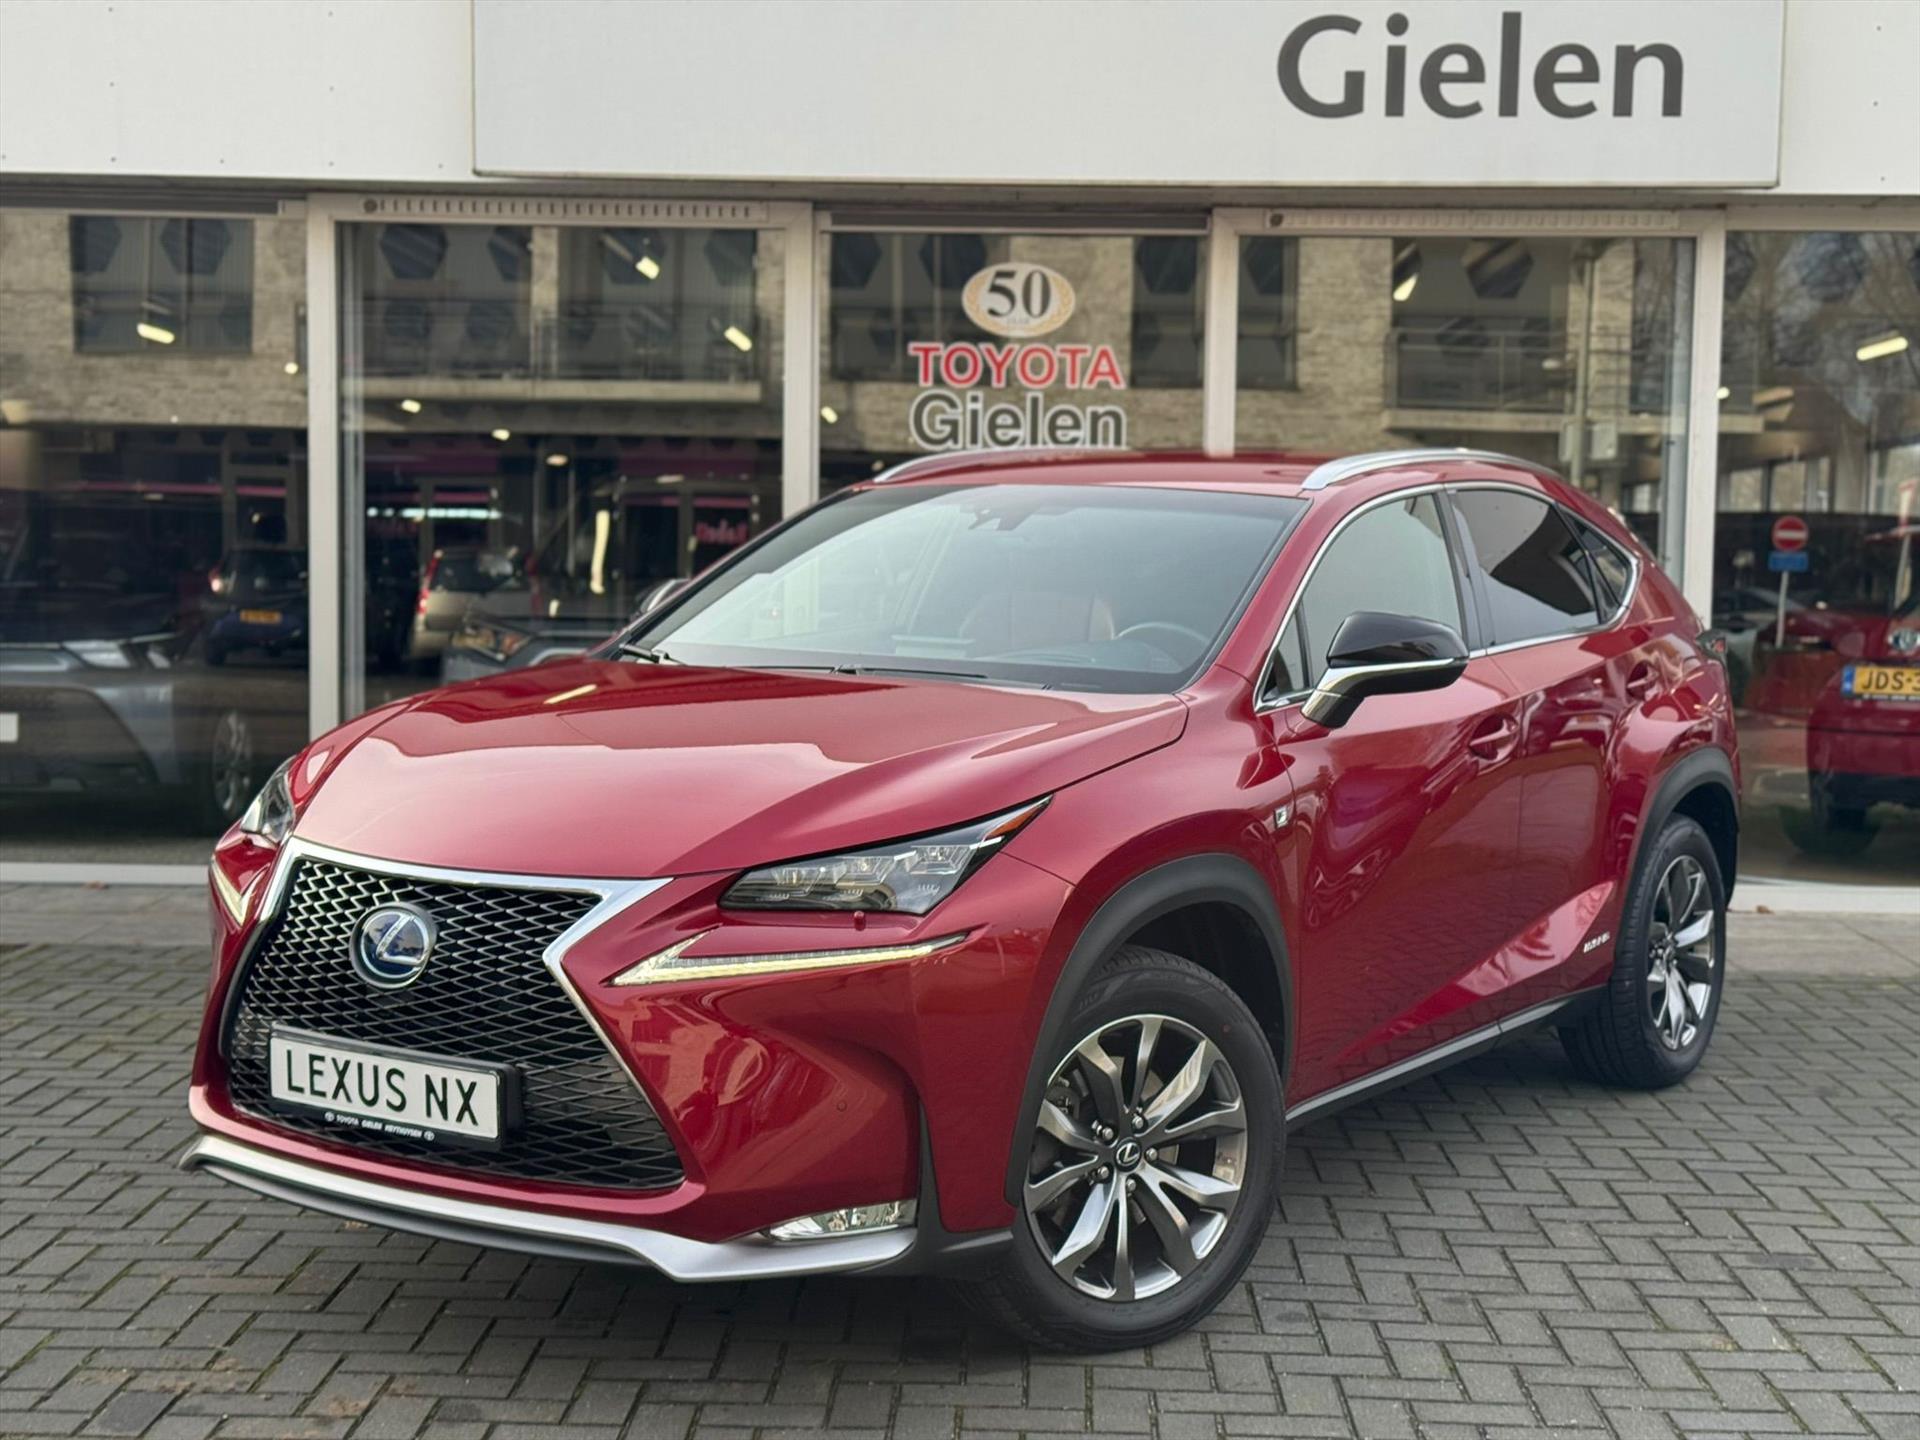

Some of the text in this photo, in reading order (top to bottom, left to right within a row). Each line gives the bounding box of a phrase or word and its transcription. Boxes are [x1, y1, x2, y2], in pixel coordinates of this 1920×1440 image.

[1277, 11, 1684, 119] Gielen
[987, 270, 1051, 318] 50
[908, 343, 1127, 389] TOYOTA
[909, 390, 1128, 449] Gielen
[286, 1049, 479, 1126] LEXUS NX
